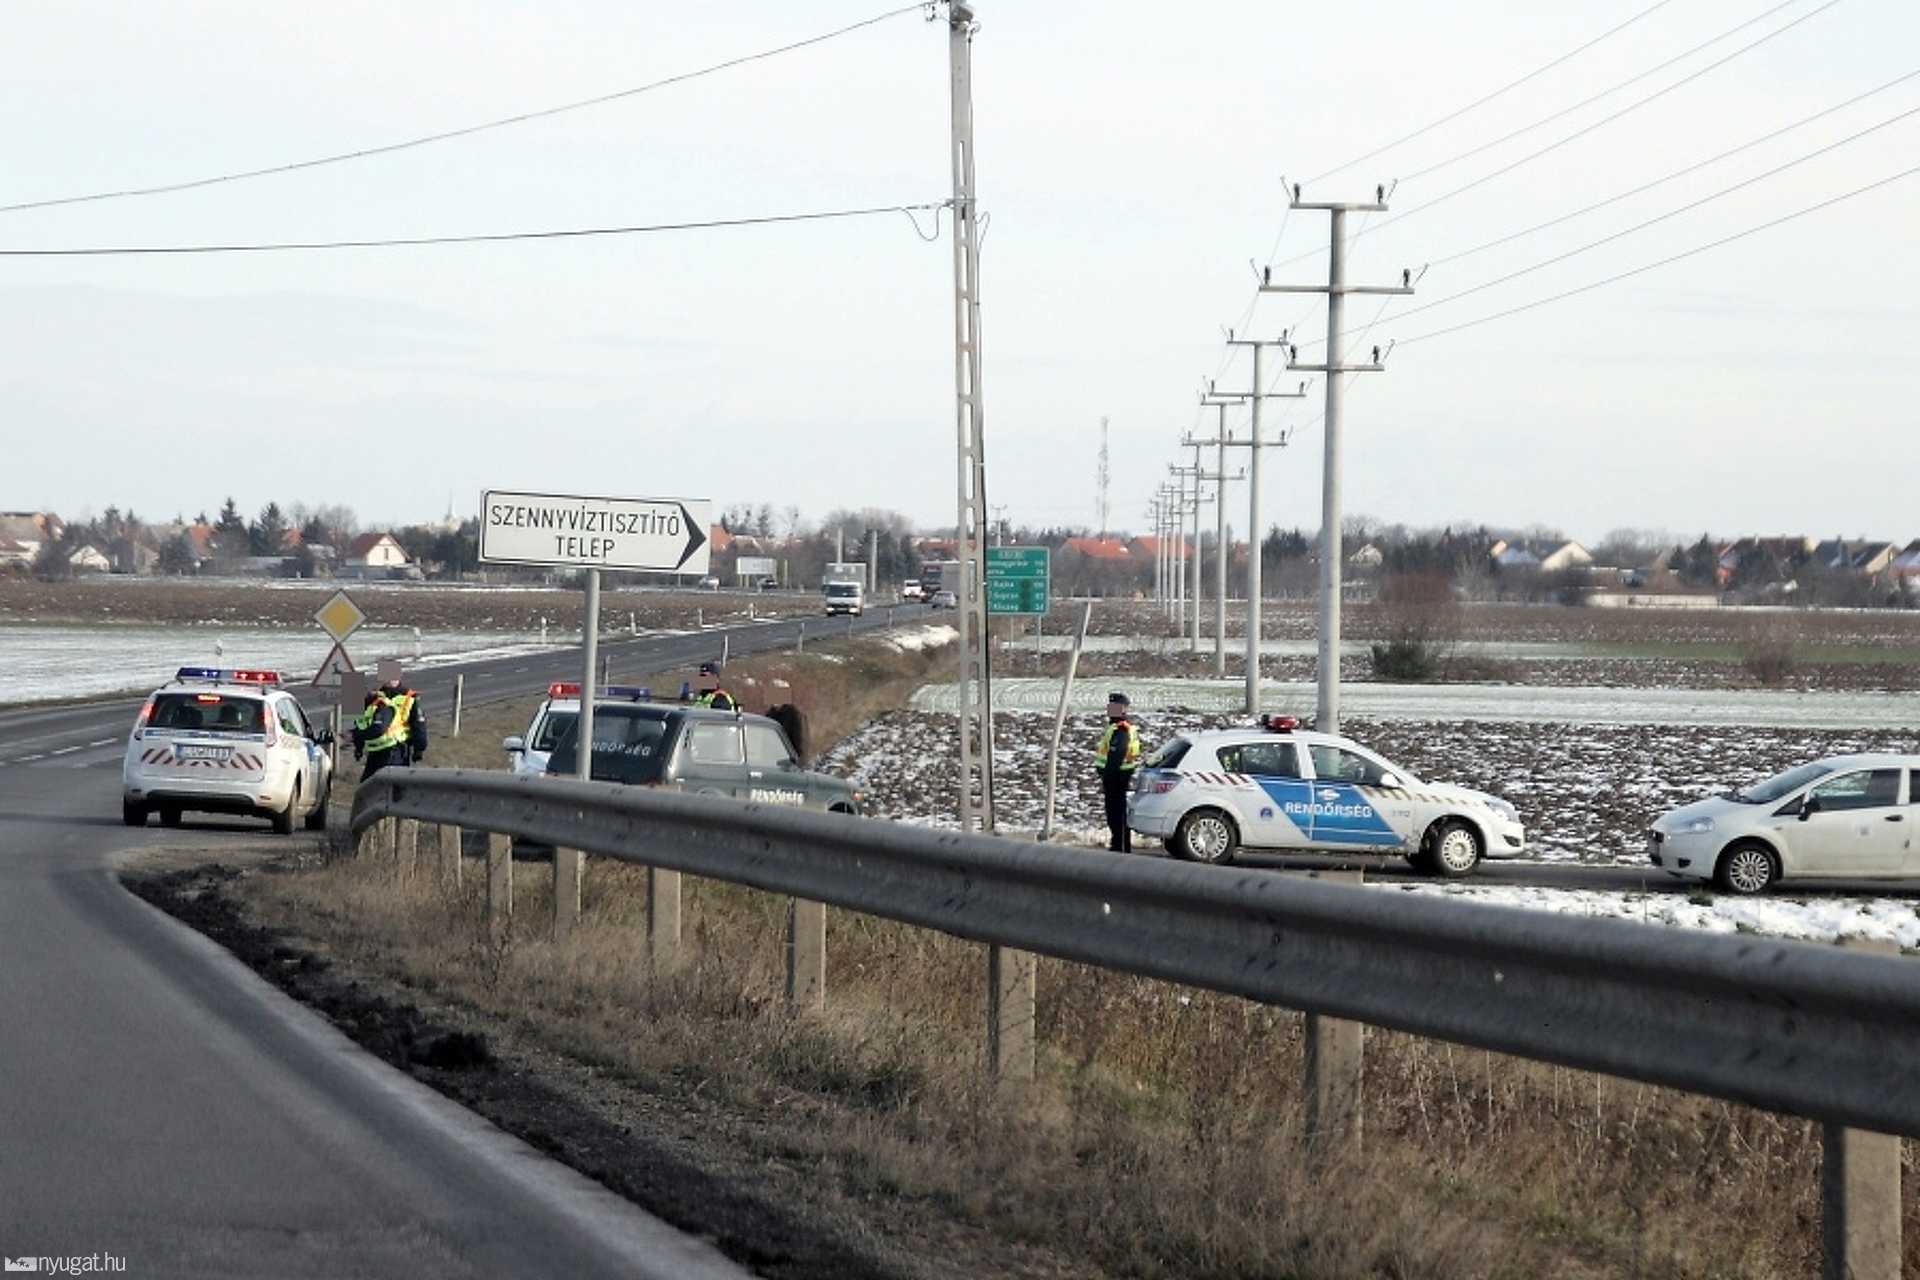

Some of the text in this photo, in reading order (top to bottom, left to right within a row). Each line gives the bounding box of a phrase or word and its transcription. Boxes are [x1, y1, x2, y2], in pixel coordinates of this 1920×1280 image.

[490, 505, 680, 536] SZENNYVÍZTISZTÍTÓ
[555, 536, 615, 558] TELEP
[1285, 801, 1373, 818] RENDŐRSÉG
